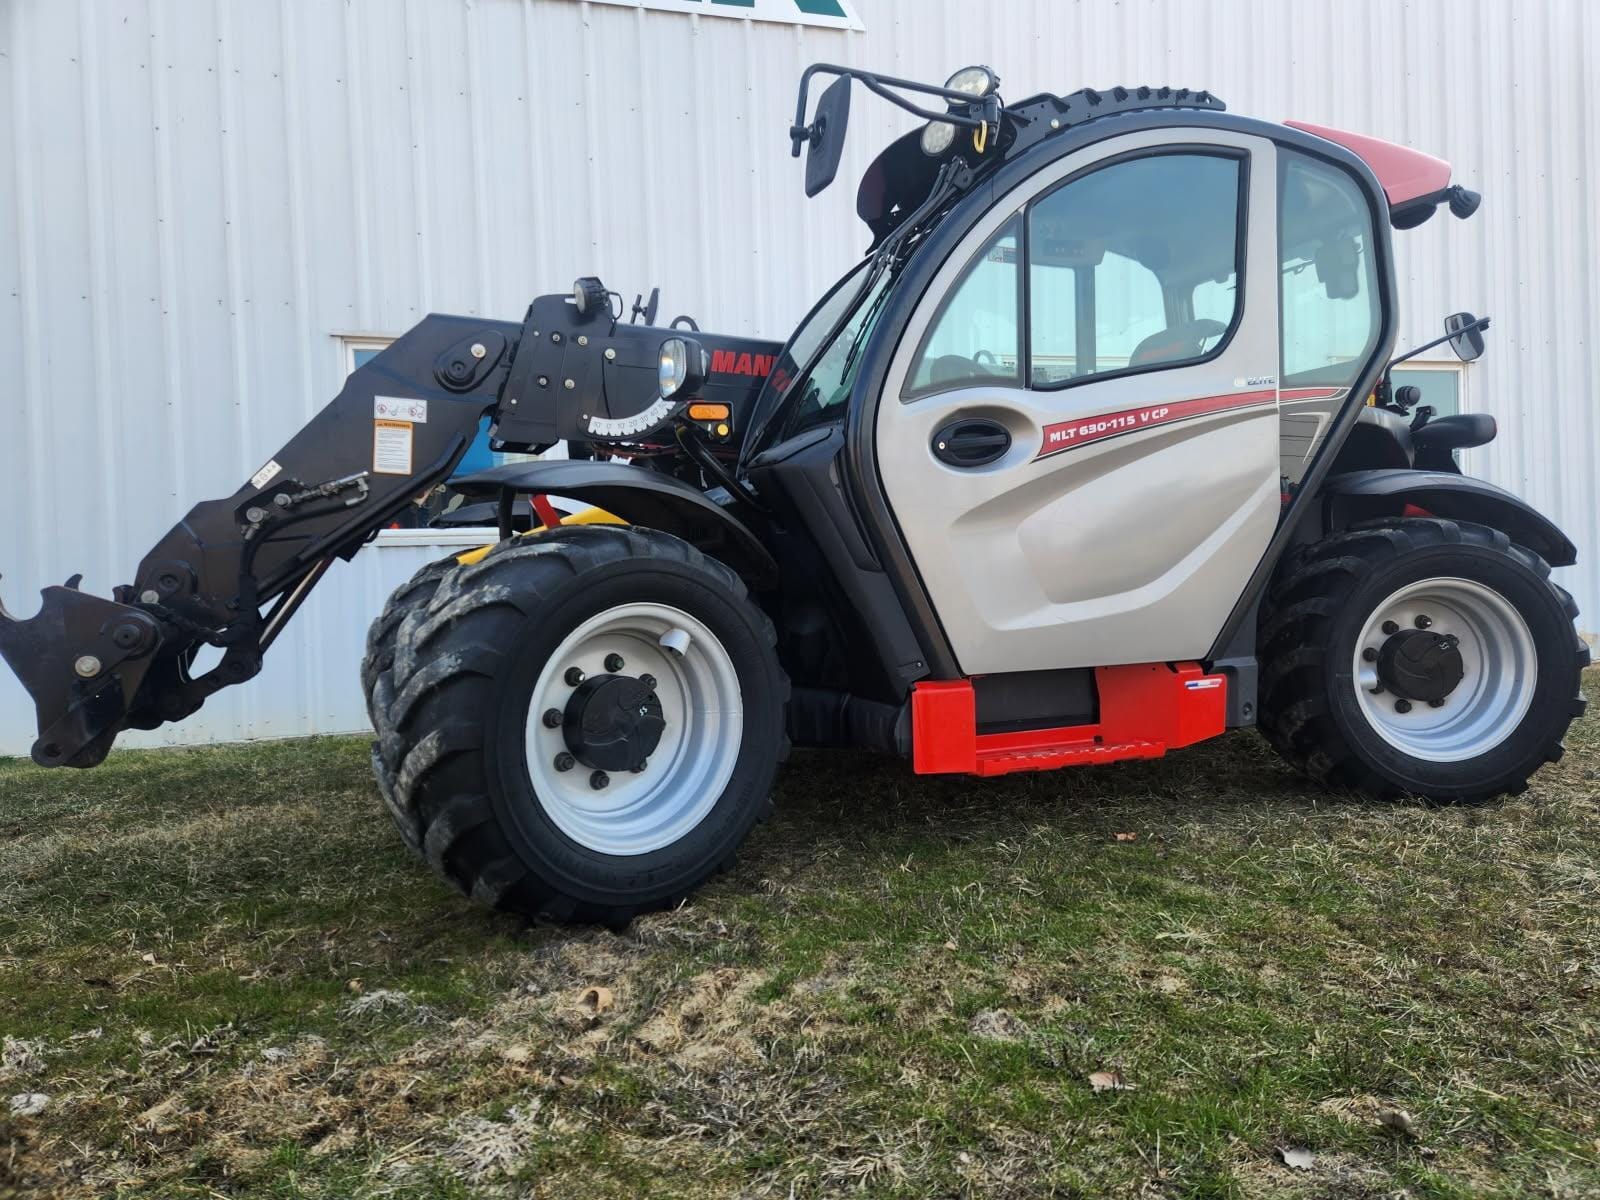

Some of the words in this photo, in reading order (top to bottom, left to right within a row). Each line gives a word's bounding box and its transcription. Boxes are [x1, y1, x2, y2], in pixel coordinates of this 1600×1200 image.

[1049, 428, 1077, 443] MLT
[1079, 415, 1136, 436] 630-115
[1140, 411, 1150, 422] V
[1151, 407, 1169, 420] CP
